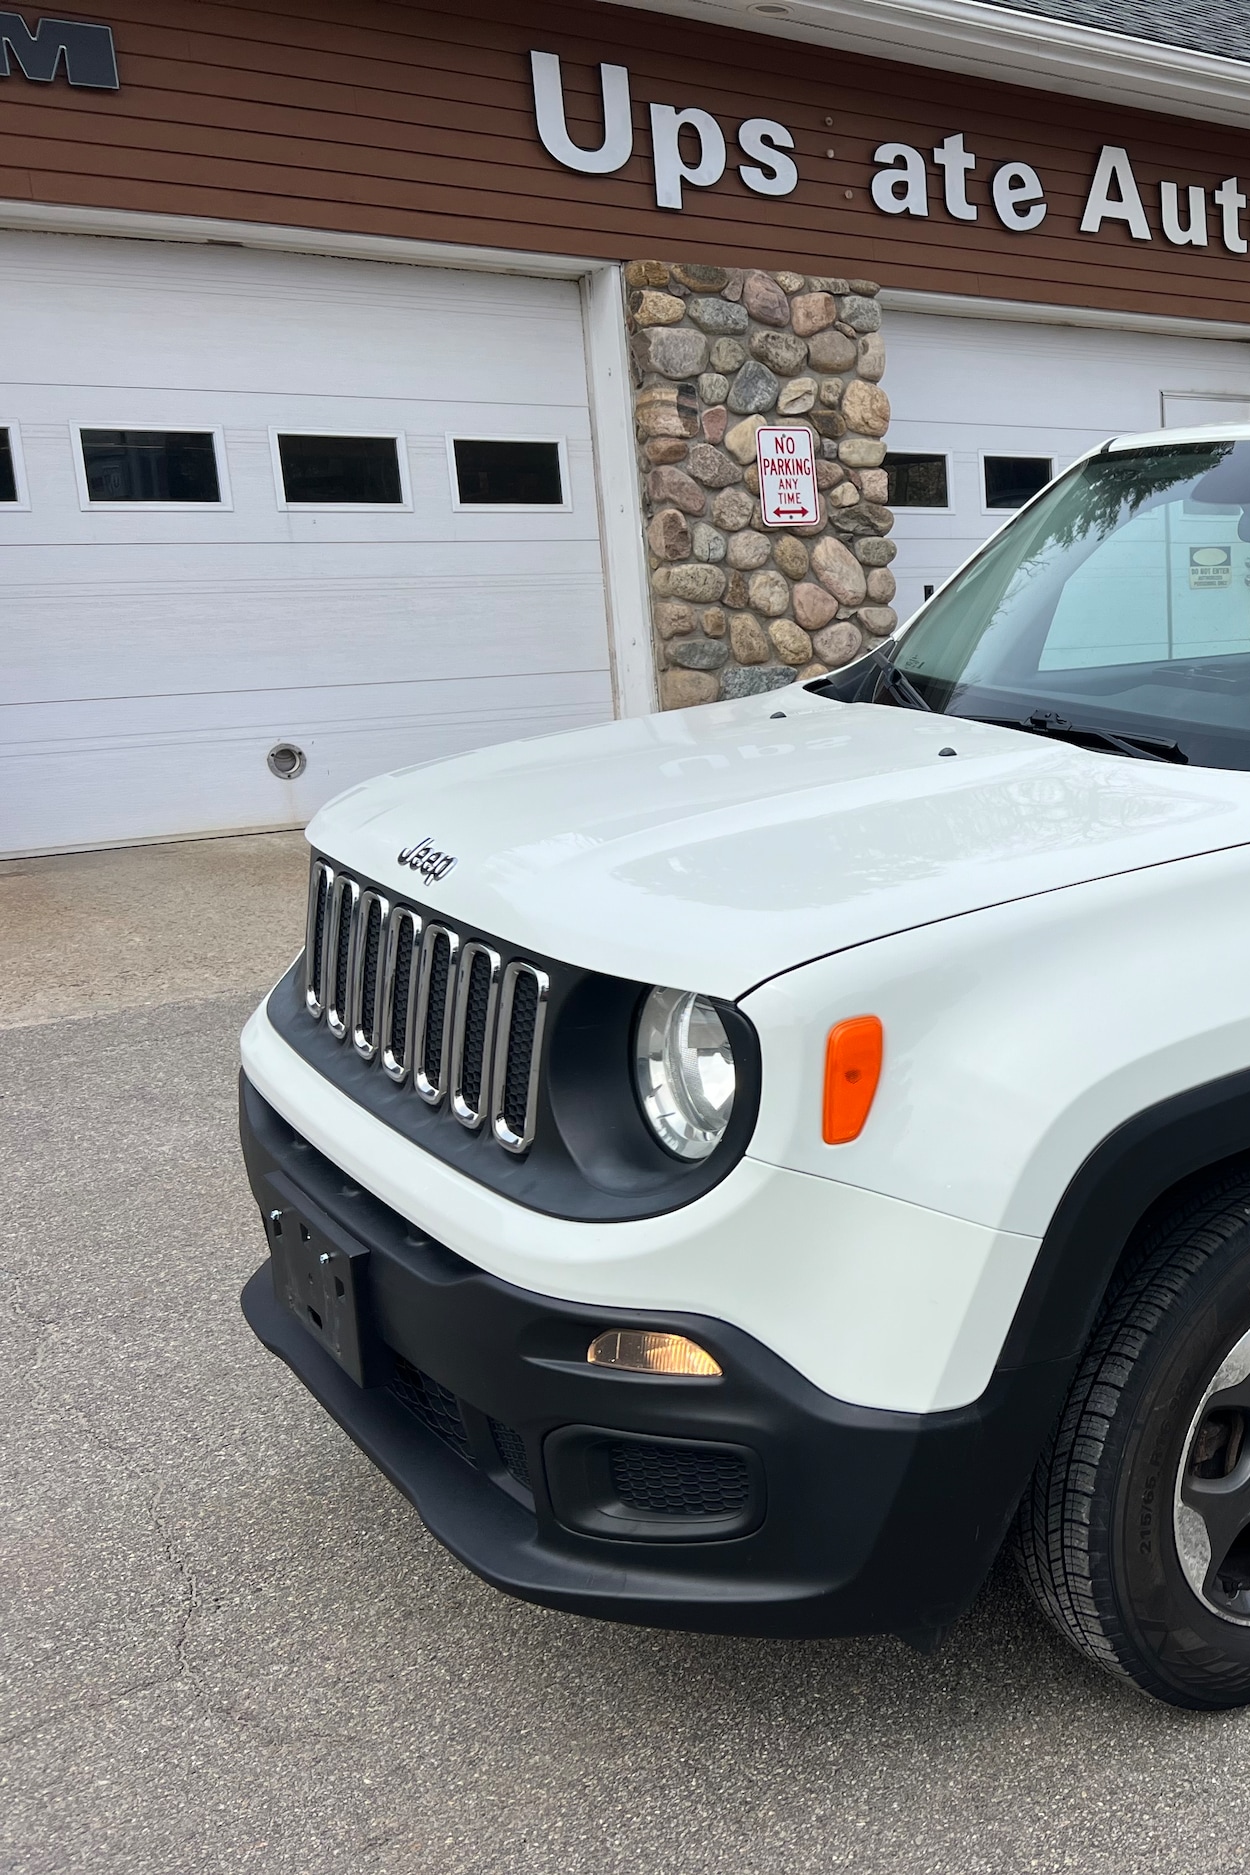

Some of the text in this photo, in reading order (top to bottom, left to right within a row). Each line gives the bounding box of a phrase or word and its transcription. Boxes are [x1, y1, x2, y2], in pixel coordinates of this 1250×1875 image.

[774, 436, 796, 454] NO
[763, 458, 811, 476] PARKING
[778, 478, 799, 490] ANY
[777, 492, 802, 505] TIME
[397, 837, 458, 886] Jeep
